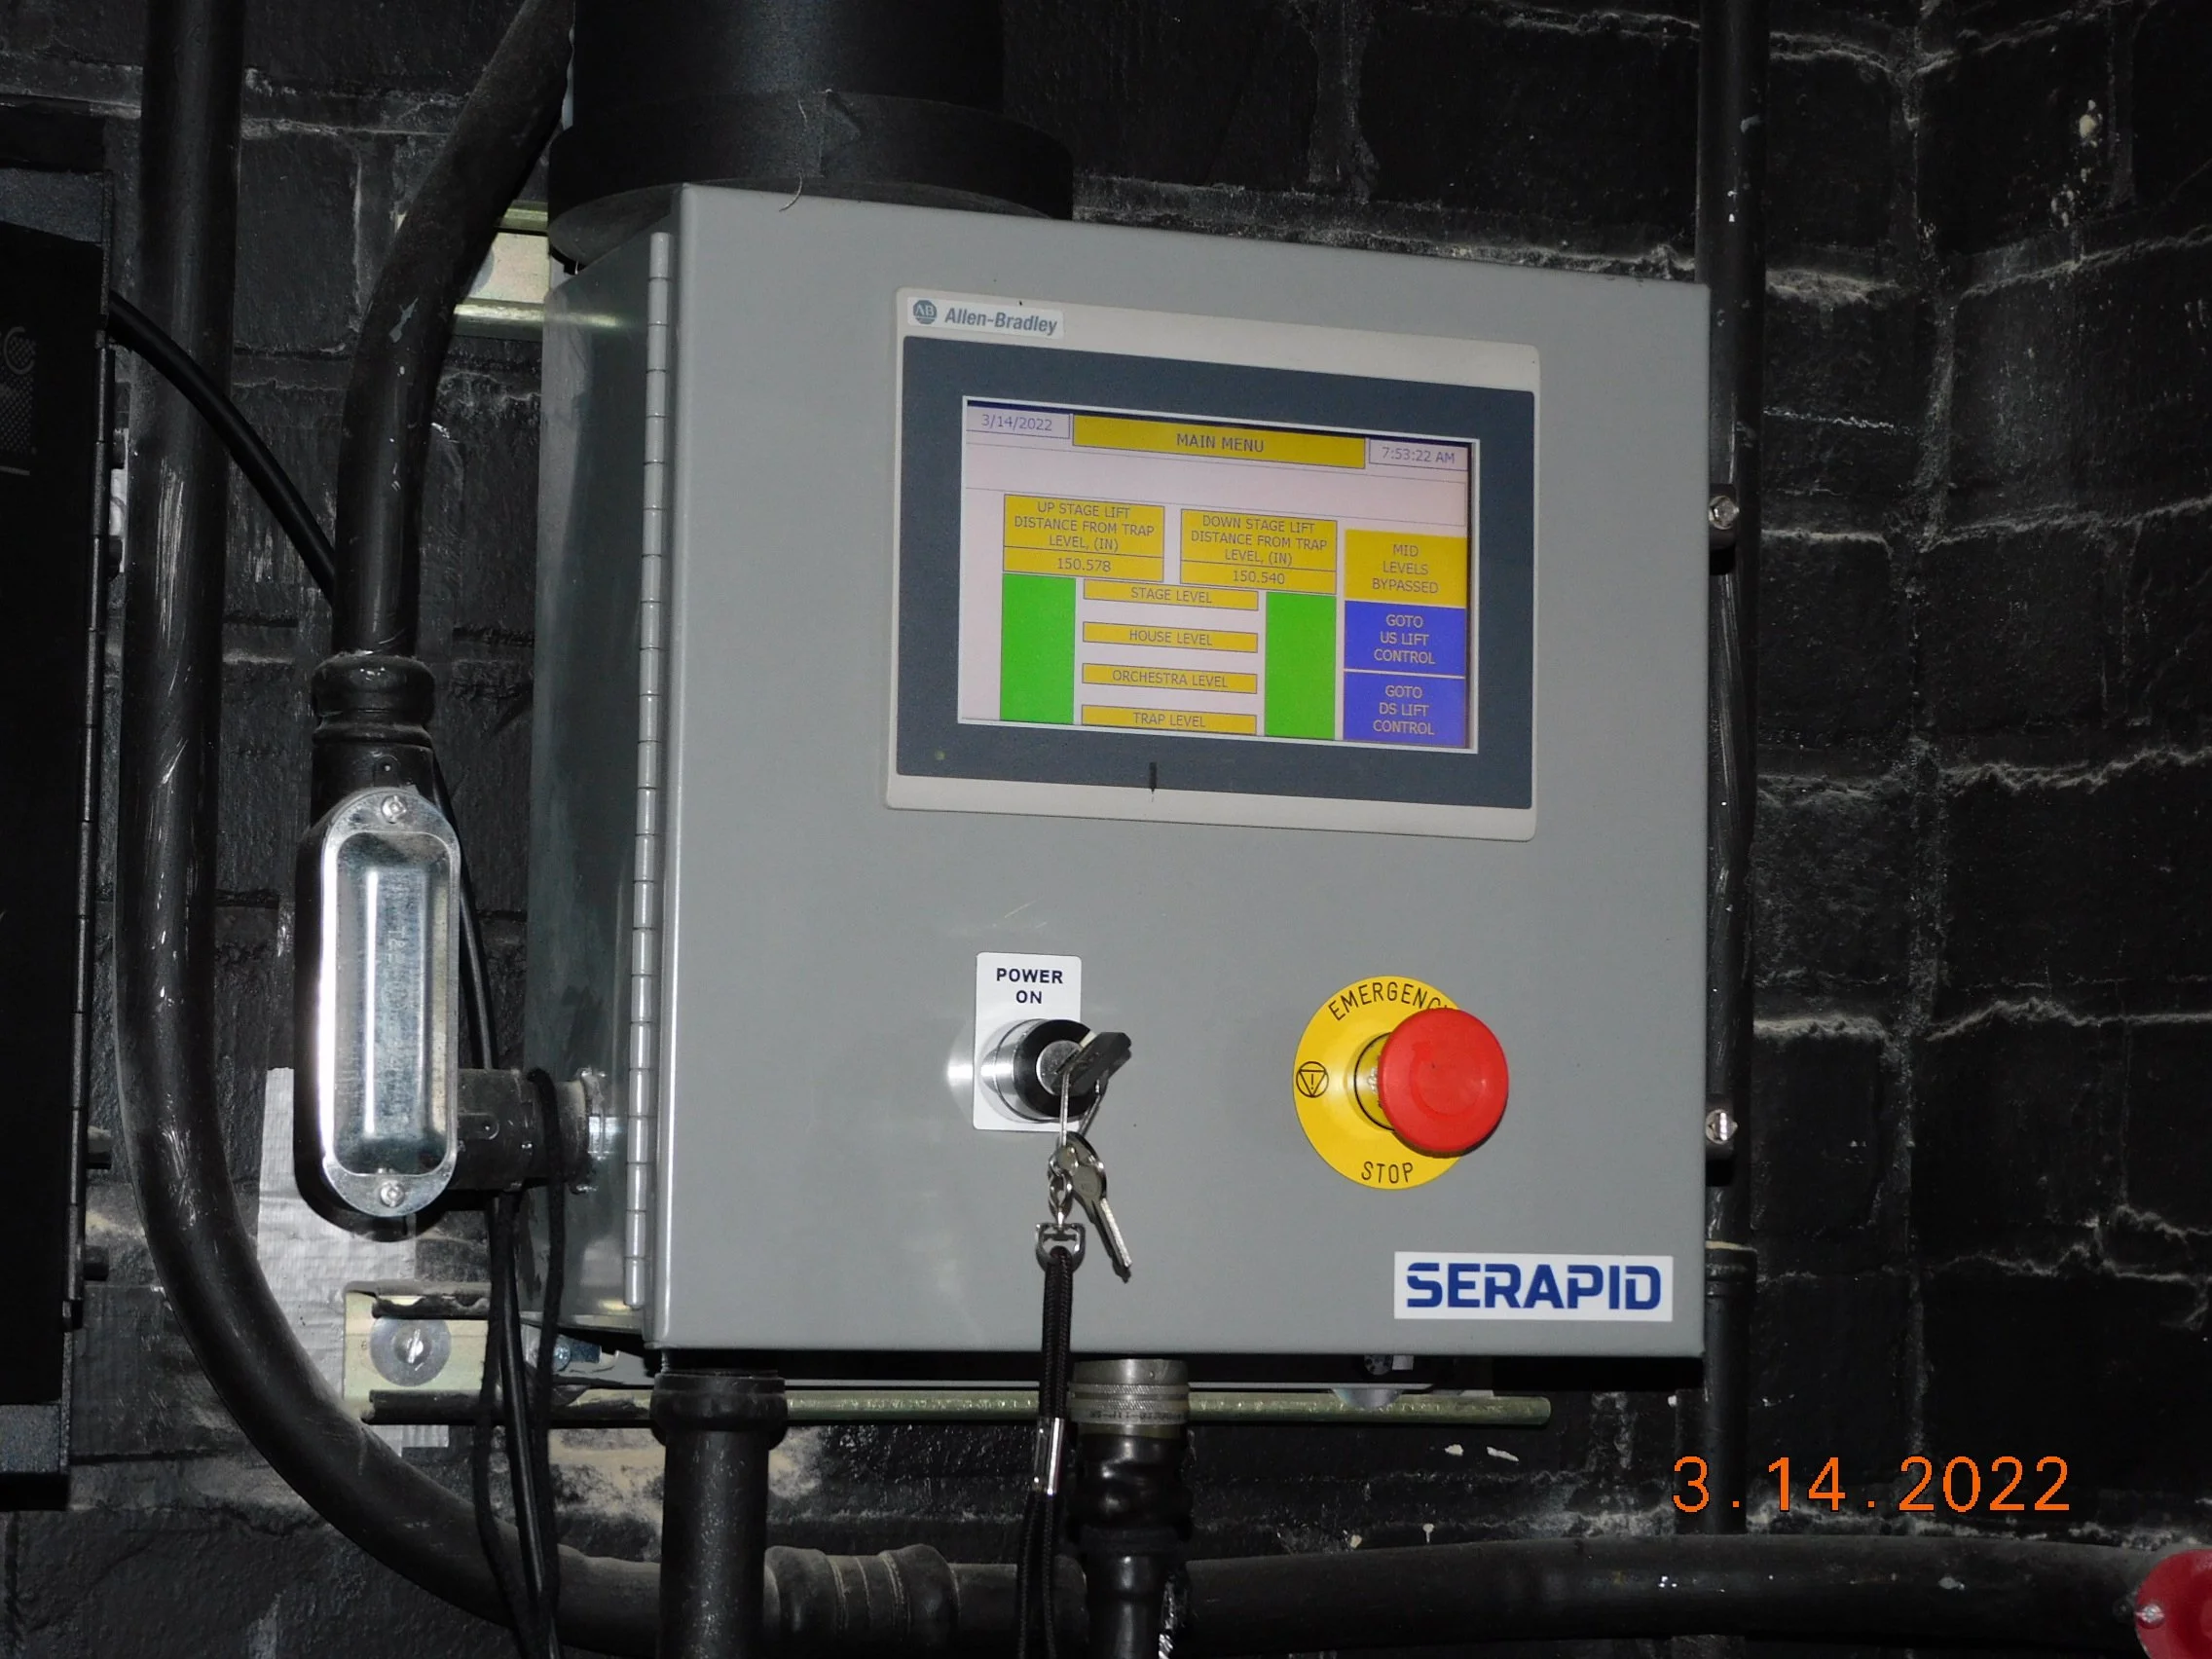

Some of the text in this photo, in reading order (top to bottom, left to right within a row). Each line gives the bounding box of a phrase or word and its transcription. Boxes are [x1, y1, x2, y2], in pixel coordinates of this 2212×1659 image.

[943, 307, 1058, 337] Allen-Bradley
[981, 414, 1052, 431] 3/14/2022
[1176, 433, 1265, 453] MAIN MENU
[1382, 447, 1456, 464] 7:53:22 AM
[1038, 501, 1130, 519] UP STAGE LIFT
[1014, 515, 1155, 536] DISTANCE FROM TRAP
[1202, 515, 1315, 535] DOWN STAGE LIFT
[1050, 535, 1119, 552] LEVEL, (IN)
[1191, 530, 1327, 551] DISTANCE FROM TRAP
[1225, 549, 1293, 567] LEVEL, (IN)
[1393, 543, 1419, 557] MID
[1057, 557, 1111, 572] 150.578
[1382, 561, 1429, 575] LEVELS
[1233, 571, 1285, 585] 150.540
[1372, 577, 1439, 594] BYPASSED
[1130, 587, 1212, 604] STAGE LEVEL
[1385, 614, 1423, 628] GOTO
[1129, 630, 1212, 646] HOUSE LEVEL
[1380, 631, 1429, 645] US LIFT
[1374, 648, 1435, 664] CONTROL
[1112, 669, 1229, 688] ORCHESTRA LEVEL
[1385, 684, 1422, 699] GOTO
[1379, 702, 1429, 717] DS LIFT
[1133, 712, 1206, 728] TRAP LEVEL
[1373, 719, 1435, 735] CONTROL
[996, 967, 1063, 984] POWER
[1015, 990, 1043, 1005] ON
[1328, 981, 1448, 1021] EMERGENC
[1361, 1161, 1414, 1184] STOP
[1406, 1262, 1662, 1310] SERAPID
